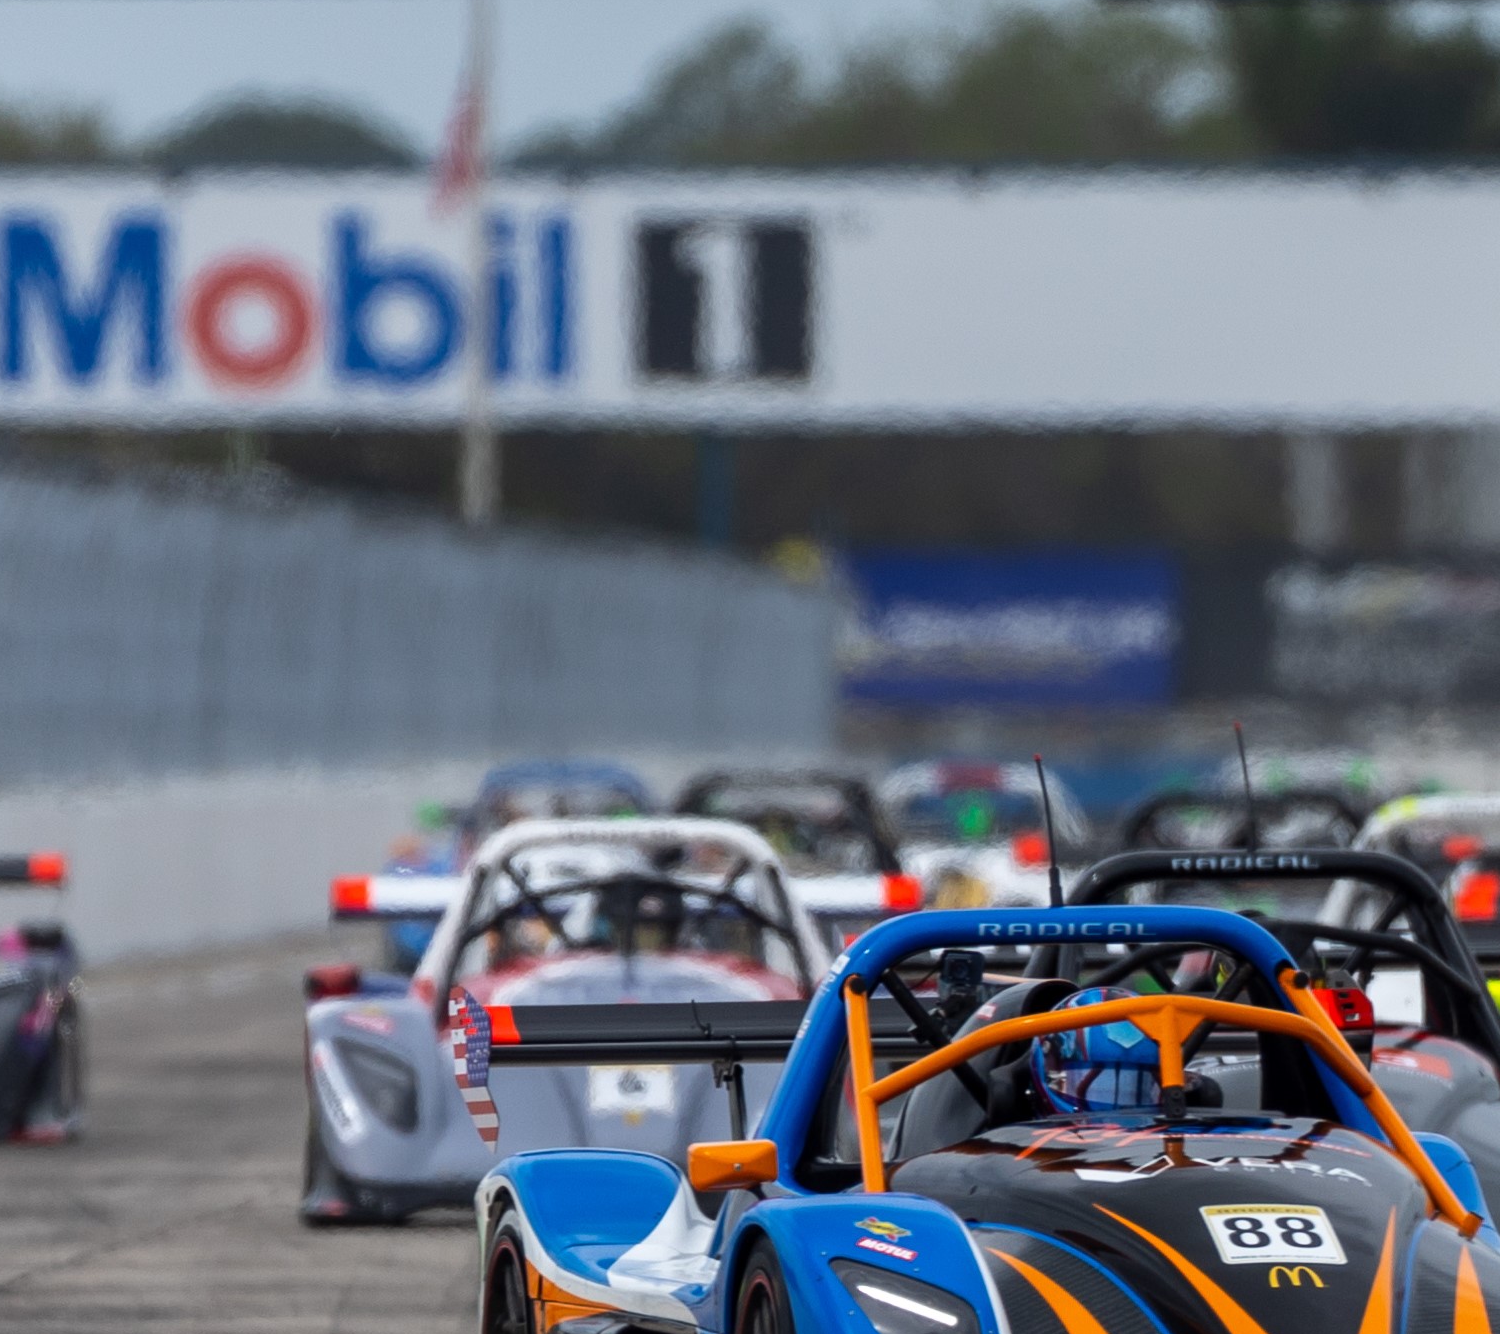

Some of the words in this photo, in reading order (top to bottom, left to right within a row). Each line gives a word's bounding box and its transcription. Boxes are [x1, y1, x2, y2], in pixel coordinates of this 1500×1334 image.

[1171, 854, 1319, 869] RADICAL
[978, 923, 1157, 936] RADICAL
[1223, 1216, 1324, 1248] 88
[858, 1237, 914, 1261] MOTUL
